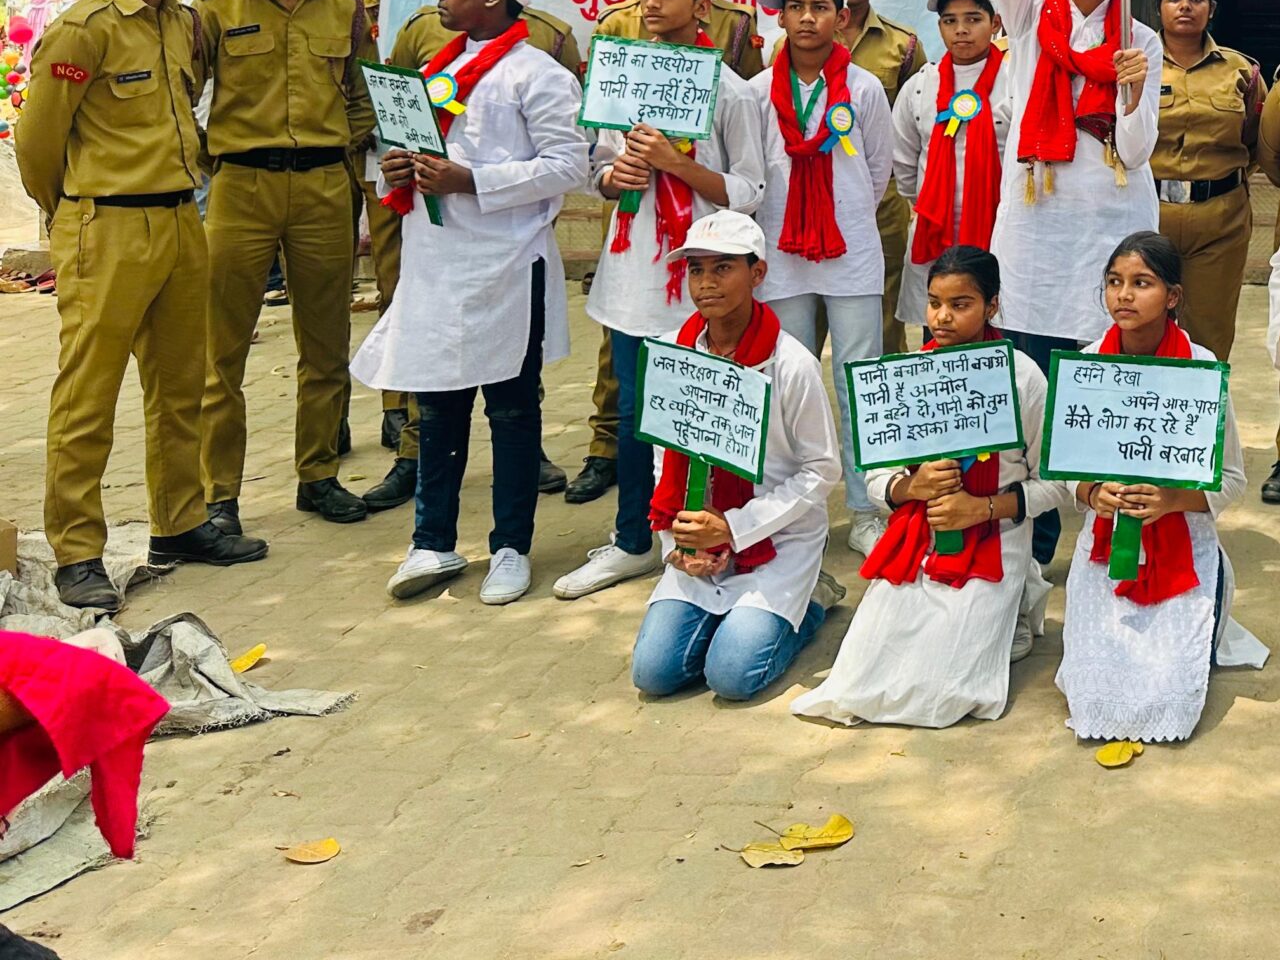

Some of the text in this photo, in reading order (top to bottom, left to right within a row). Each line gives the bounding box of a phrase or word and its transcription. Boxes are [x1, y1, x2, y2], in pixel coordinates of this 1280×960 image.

[57, 66, 83, 79] NCC
[599, 47, 704, 74] सभी का सहयोग
[599, 74, 712, 104] पानी का नहीं होगा
[654, 357, 743, 392] जल संरक्षण को
[859, 363, 887, 385] पानी
[942, 354, 969, 373] पानी
[972, 350, 1008, 369] बचाओ
[1073, 363, 1143, 387] हमने देखा
[680, 385, 728, 408] अपनाना
[861, 375, 968, 406] पानी है अनमोल
[1122, 391, 1219, 415] अपने आस-पास
[650, 395, 756, 441] हर व्यक्ति तक जल
[865, 412, 878, 424] ना
[884, 403, 910, 421] बहने
[937, 396, 962, 416] पानी
[967, 391, 986, 410] को
[987, 393, 1008, 414] तुम
[1065, 404, 1093, 429] कैसे
[1098, 408, 1130, 430] लोग
[1134, 417, 1157, 432] कर
[1161, 412, 1179, 435] रहे
[867, 424, 901, 446] जानो
[907, 421, 948, 441] इसका
[1118, 435, 1154, 461] पानी
